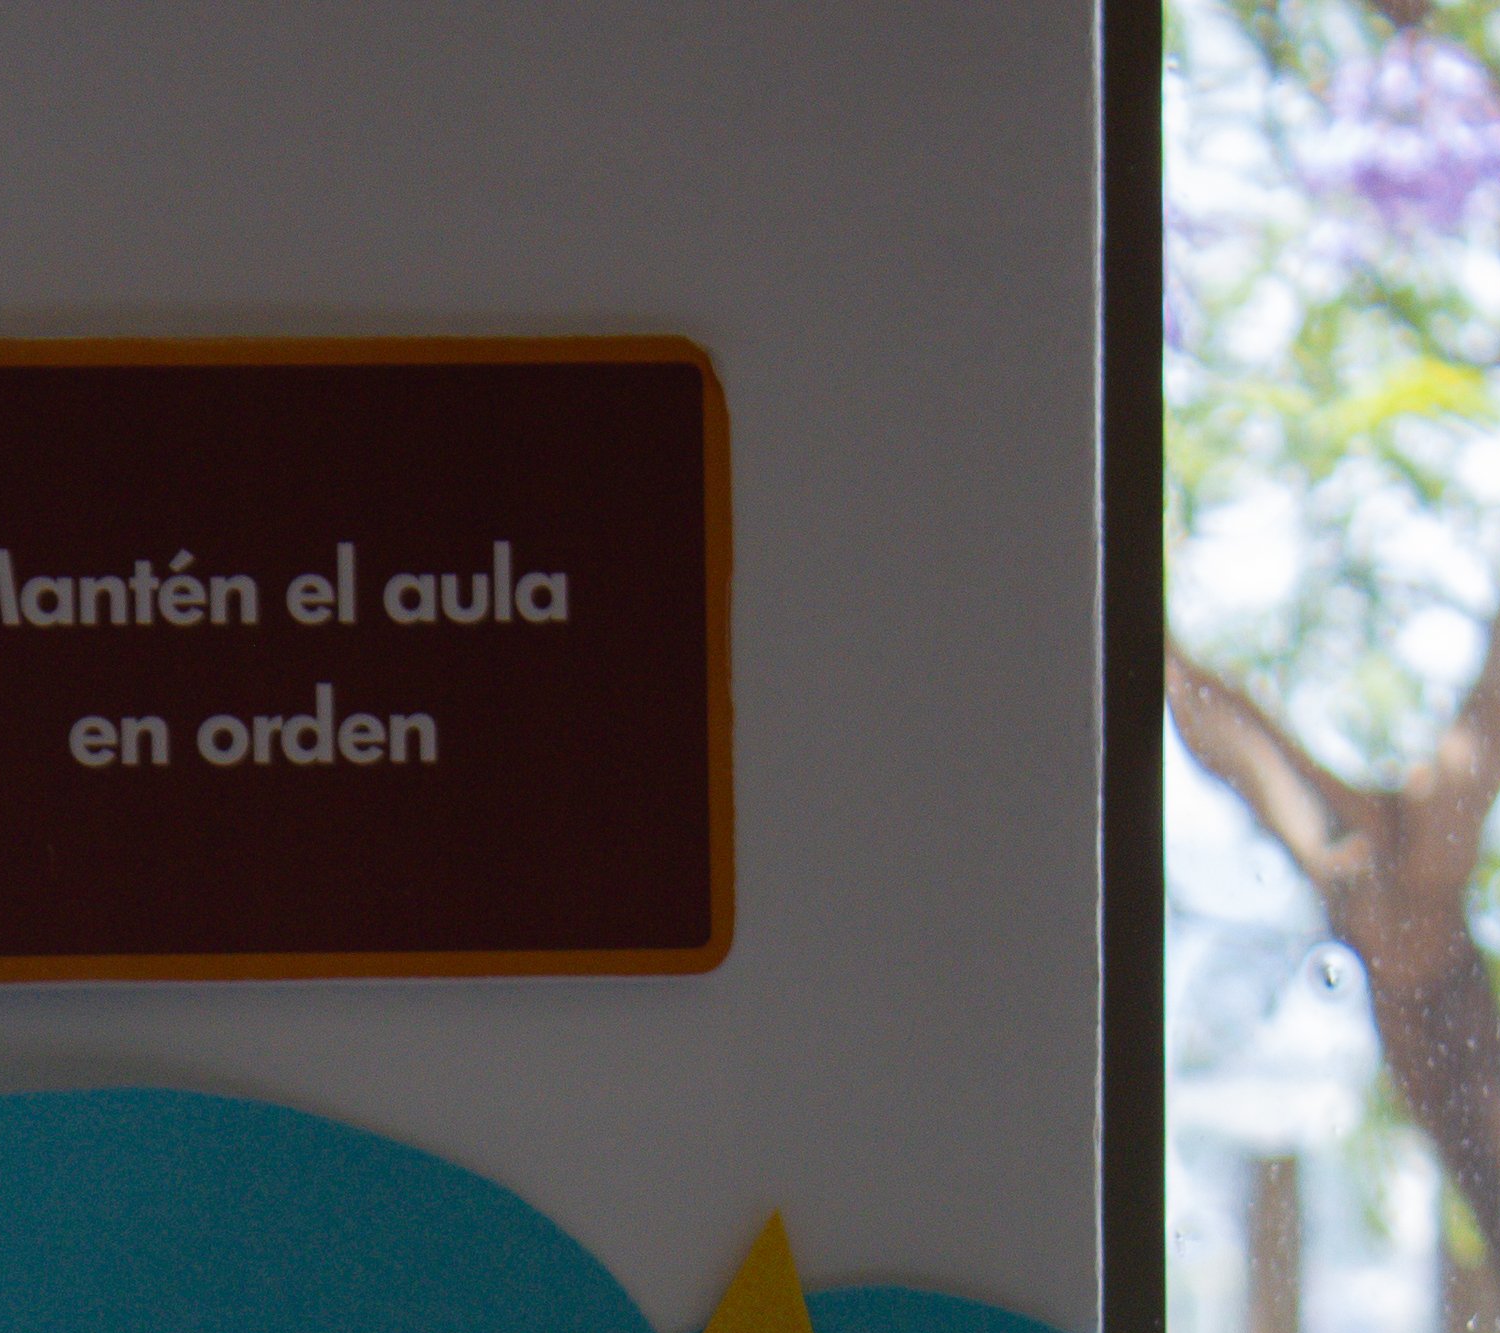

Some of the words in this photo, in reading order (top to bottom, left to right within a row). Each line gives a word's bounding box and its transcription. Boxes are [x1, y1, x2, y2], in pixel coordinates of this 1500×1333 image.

[285, 541, 356, 626] el
[382, 540, 569, 625] aula
[68, 710, 170, 767] en
[196, 682, 438, 766] orden
